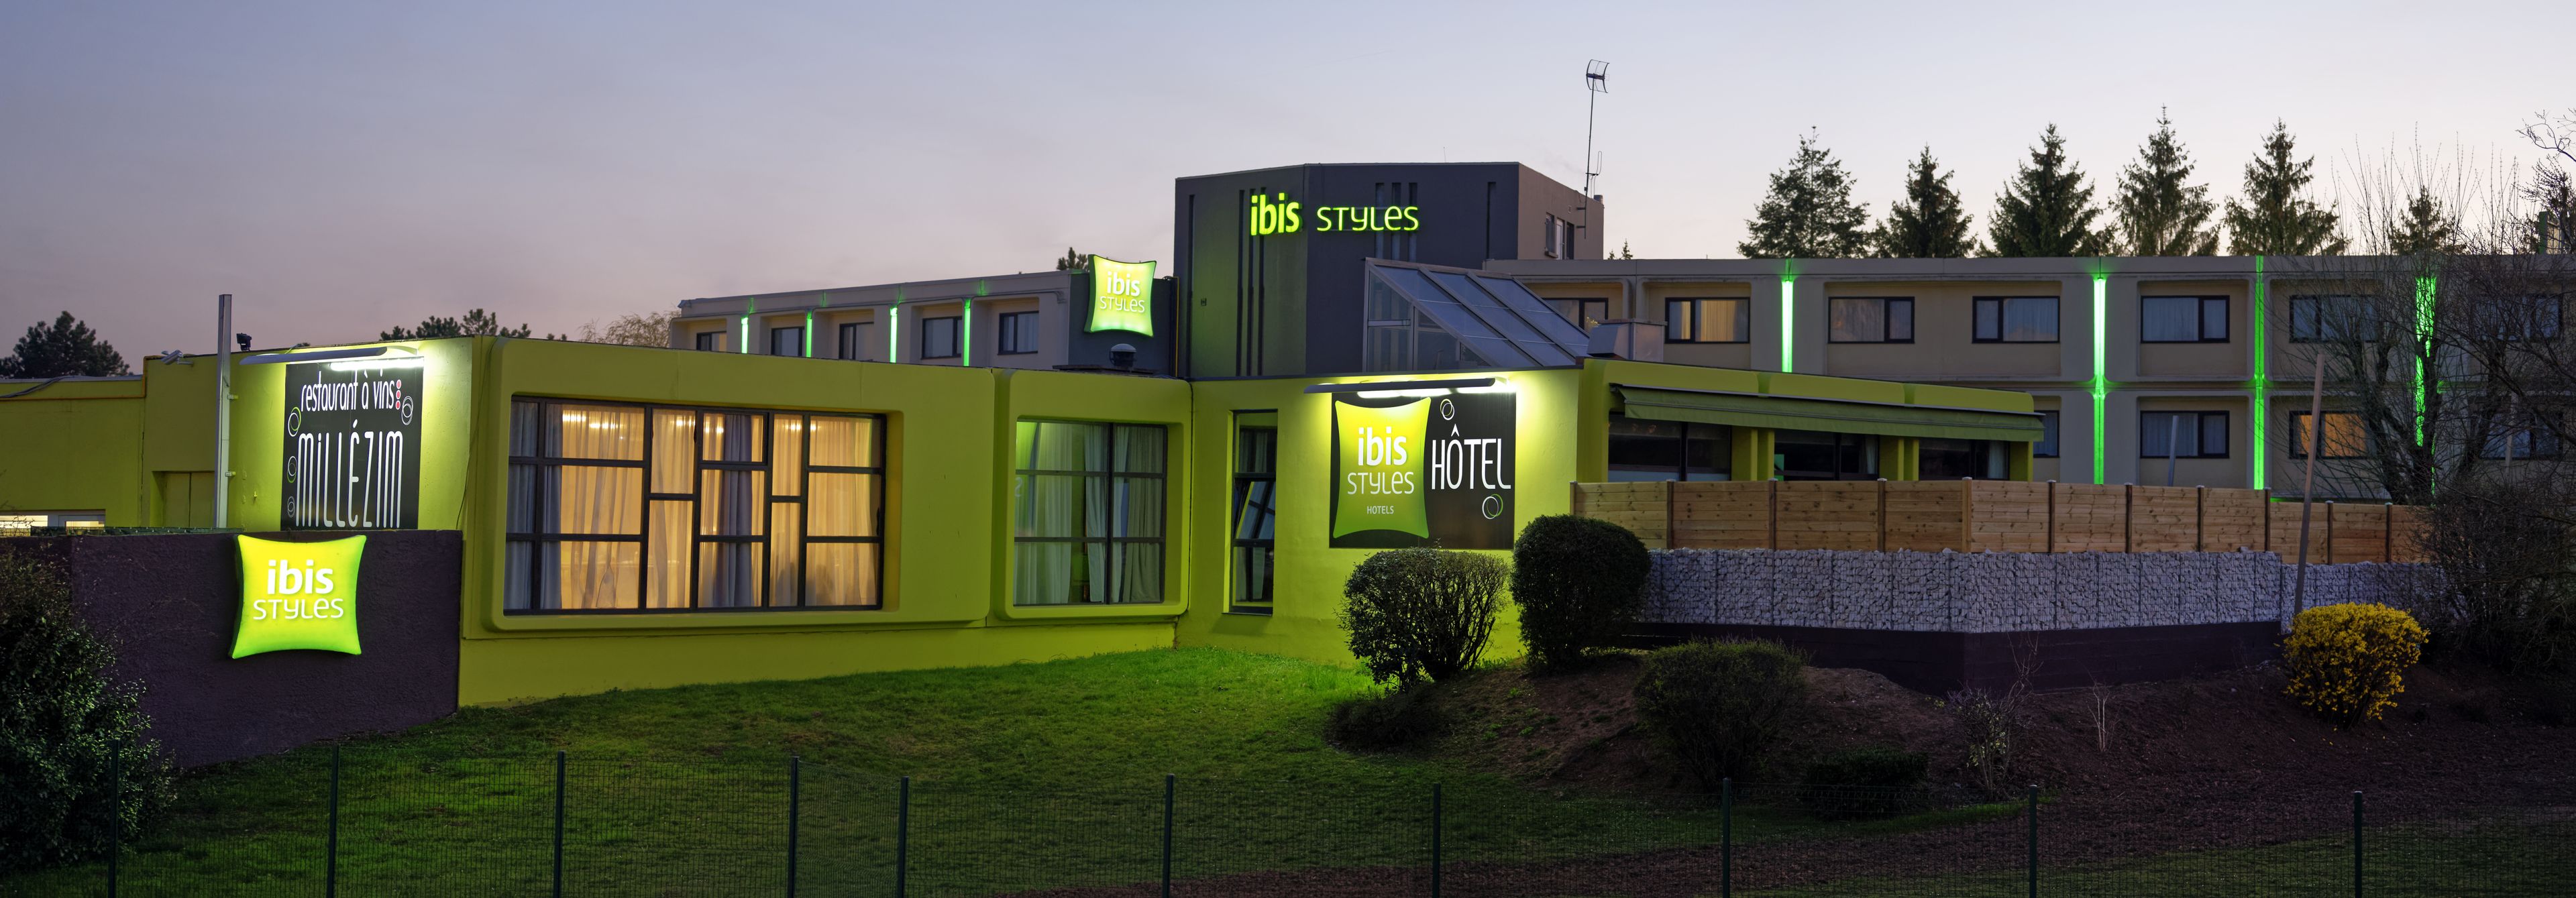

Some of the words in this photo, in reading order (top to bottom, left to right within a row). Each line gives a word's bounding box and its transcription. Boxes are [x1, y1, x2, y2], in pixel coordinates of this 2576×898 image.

[1250, 192, 1300, 236] ibis
[1107, 271, 1140, 296] ibis
[301, 370, 358, 412] restaurant
[362, 370, 369, 410] à
[373, 369, 394, 410] vins
[1358, 427, 1407, 466] ibis
[1432, 423, 1511, 490] HÔTEL
[1366, 506, 1394, 514] HOTELS
[267, 559, 334, 595] ibis
